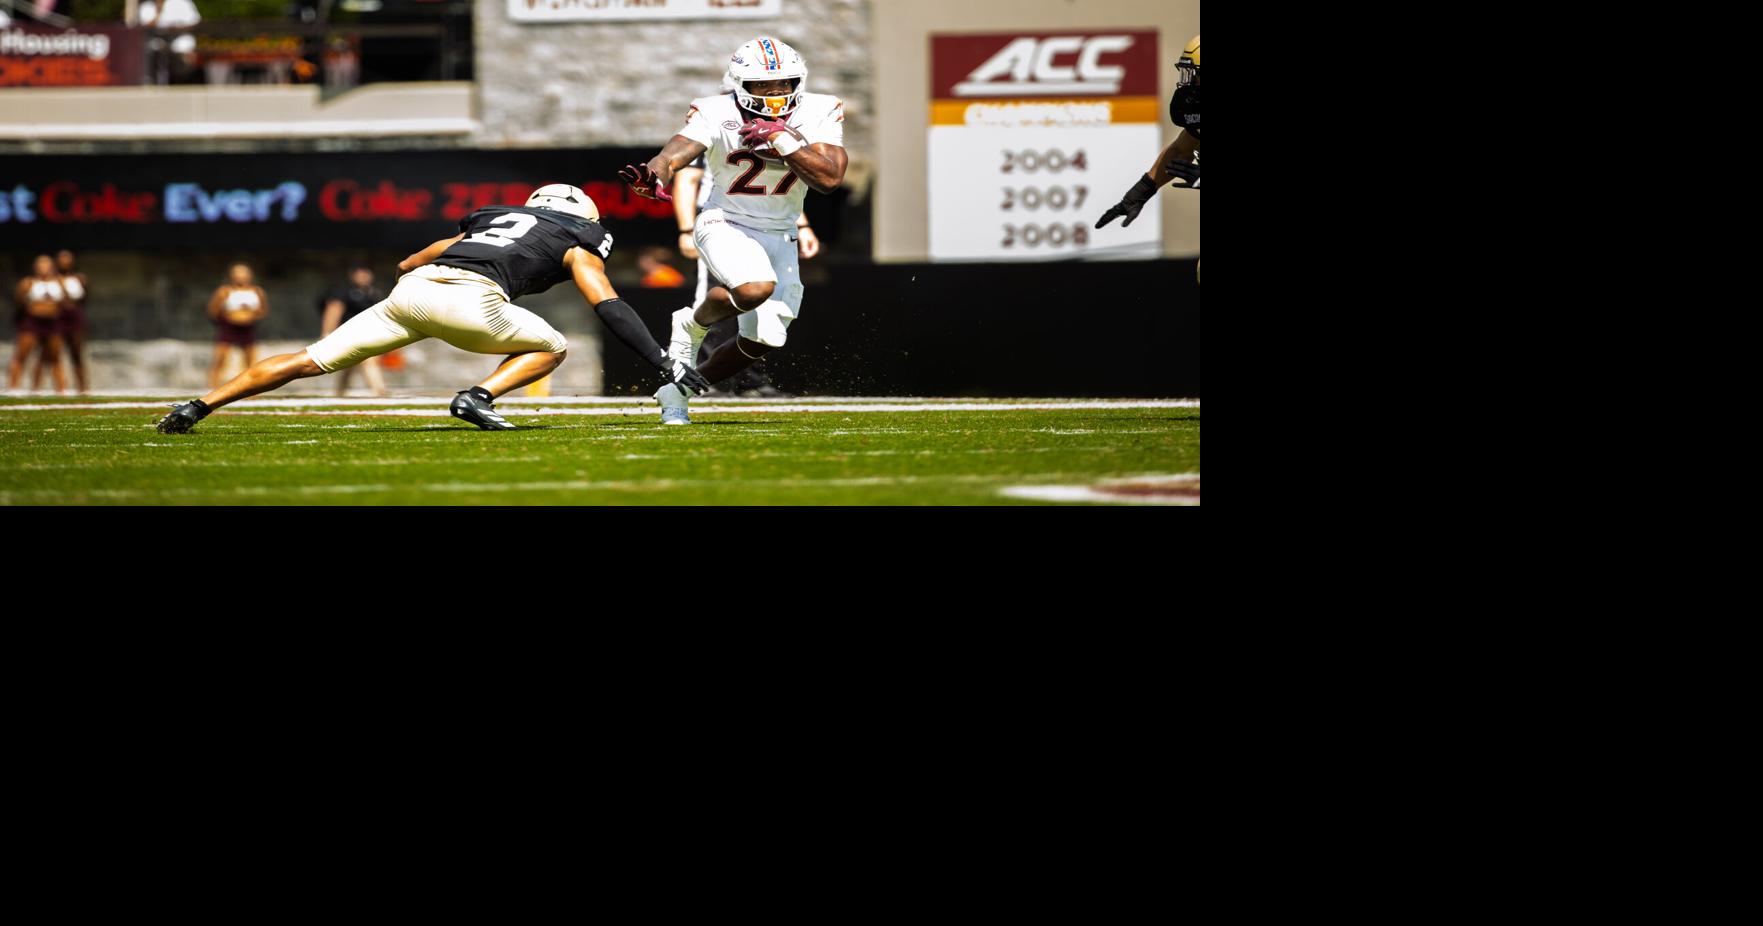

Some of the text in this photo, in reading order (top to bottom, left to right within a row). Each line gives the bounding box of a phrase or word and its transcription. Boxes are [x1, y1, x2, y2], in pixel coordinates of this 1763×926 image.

[0, 28, 110, 61] Housing
[956, 35, 1133, 94] ACC
[1000, 149, 1088, 173] 2004
[40, 182, 156, 223] Coke
[164, 182, 307, 223] Ever?
[318, 179, 431, 222] Coke
[1000, 185, 1088, 210] 2007
[461, 212, 538, 248] 2
[1000, 223, 1089, 248] 2008
